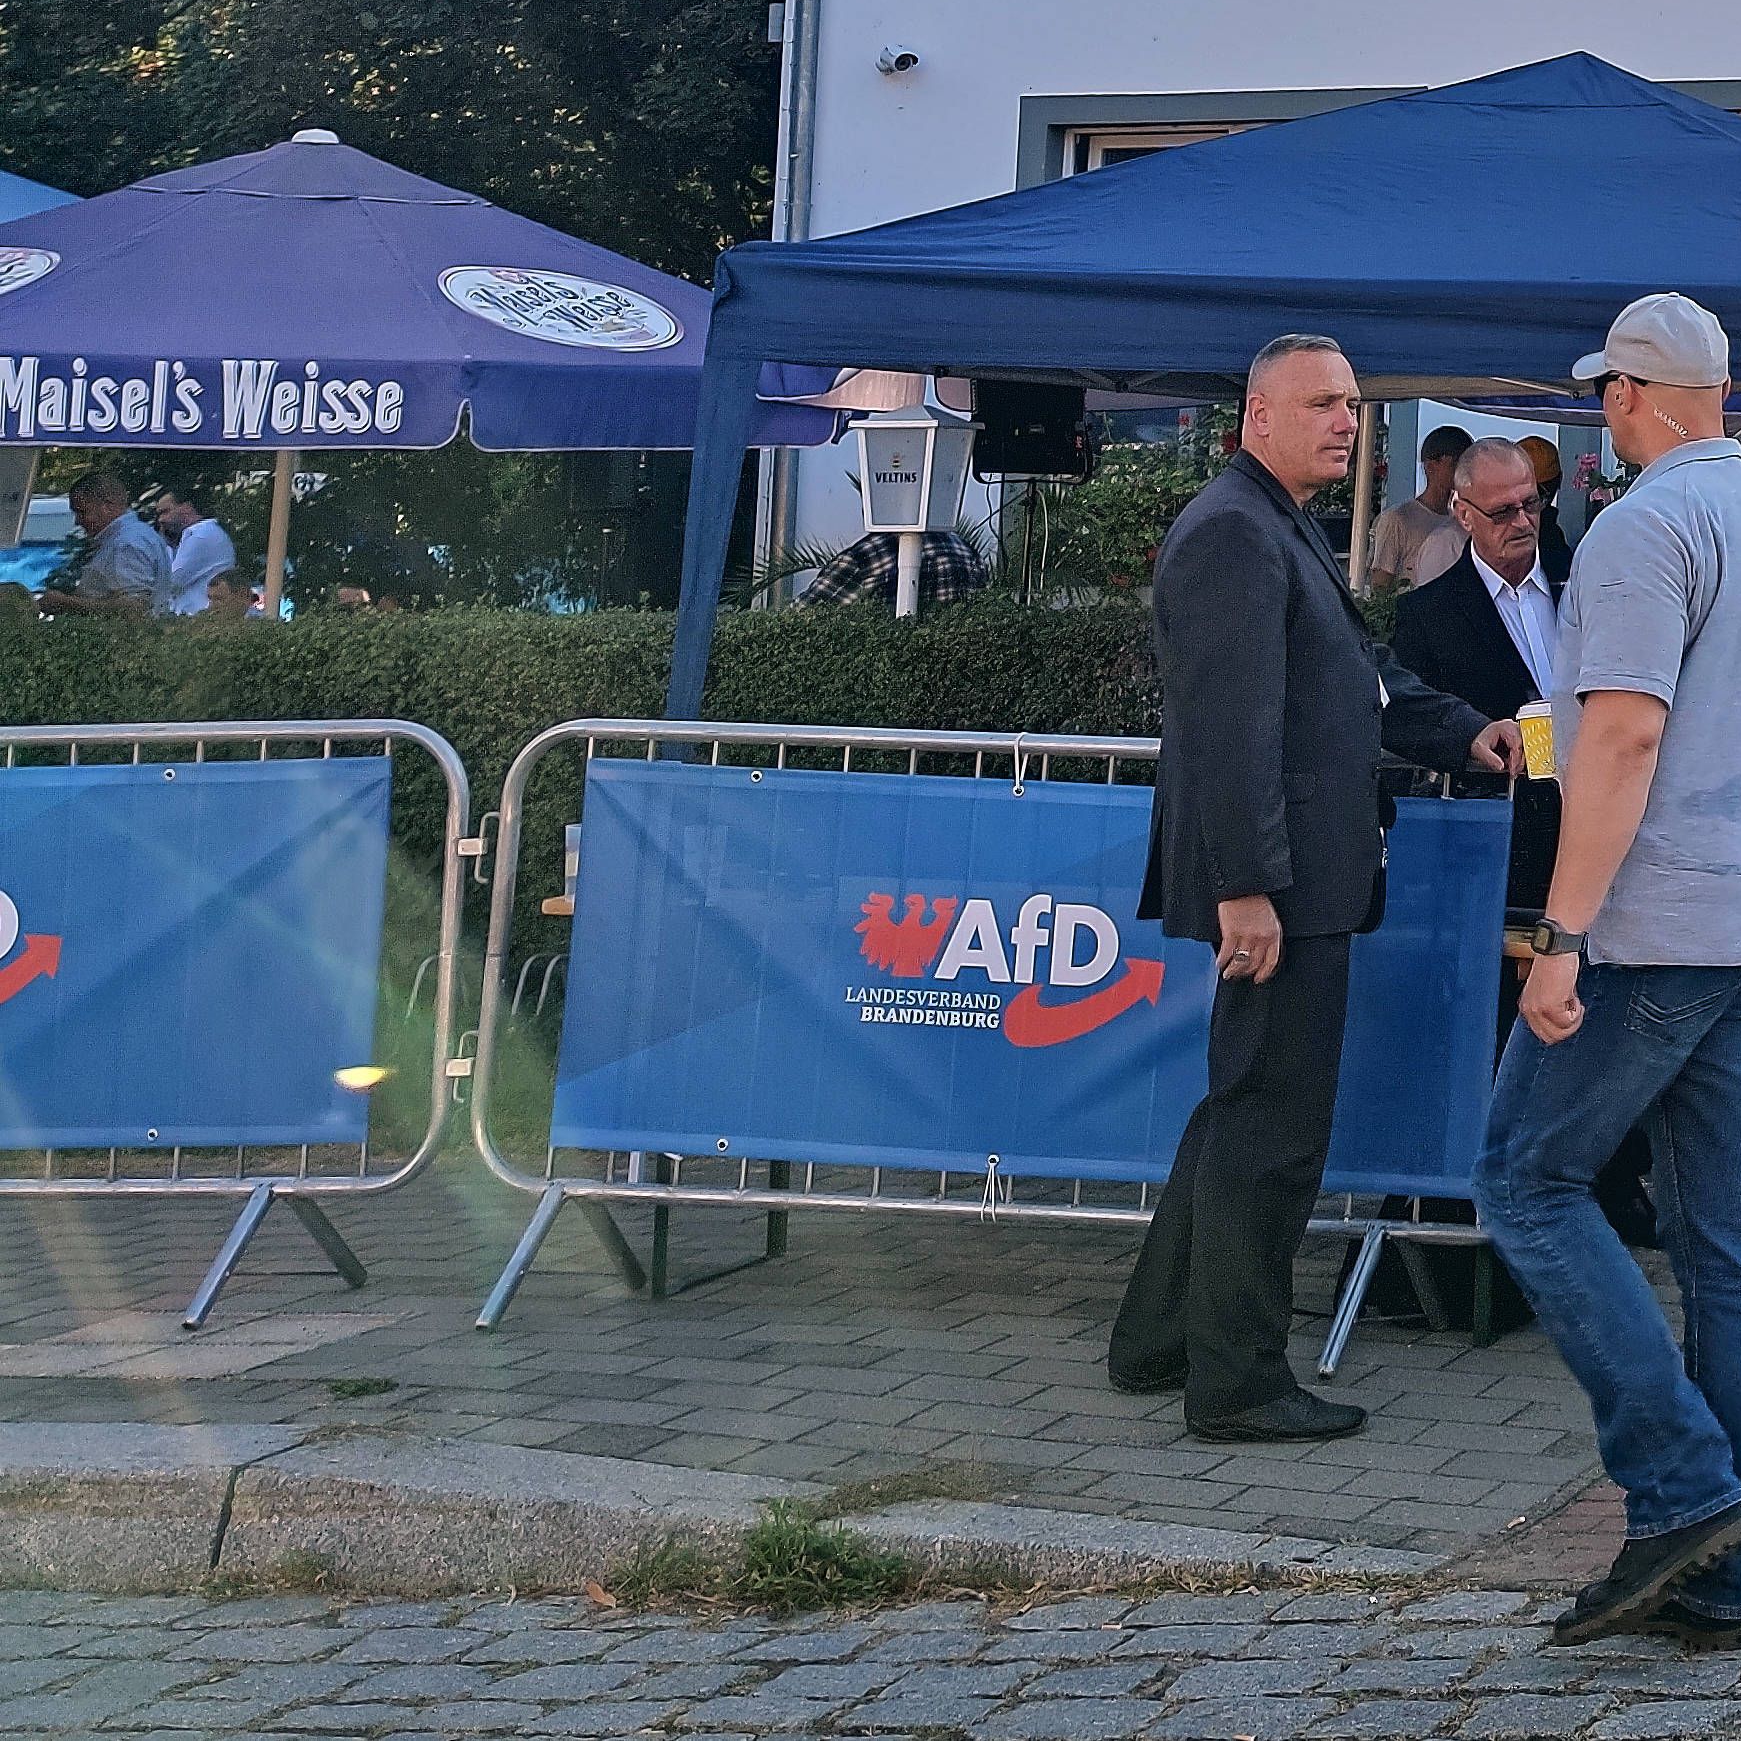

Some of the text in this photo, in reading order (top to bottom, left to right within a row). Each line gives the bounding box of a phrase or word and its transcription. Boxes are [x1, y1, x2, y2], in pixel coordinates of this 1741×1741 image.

[0, 356, 404, 440] Maisel's Weisse
[875, 471, 918, 484] VELTINS
[933, 893, 1120, 986] AfD
[845, 986, 1001, 1010] LANDESVERBAND
[860, 1006, 1001, 1029] BRANDENBURG
